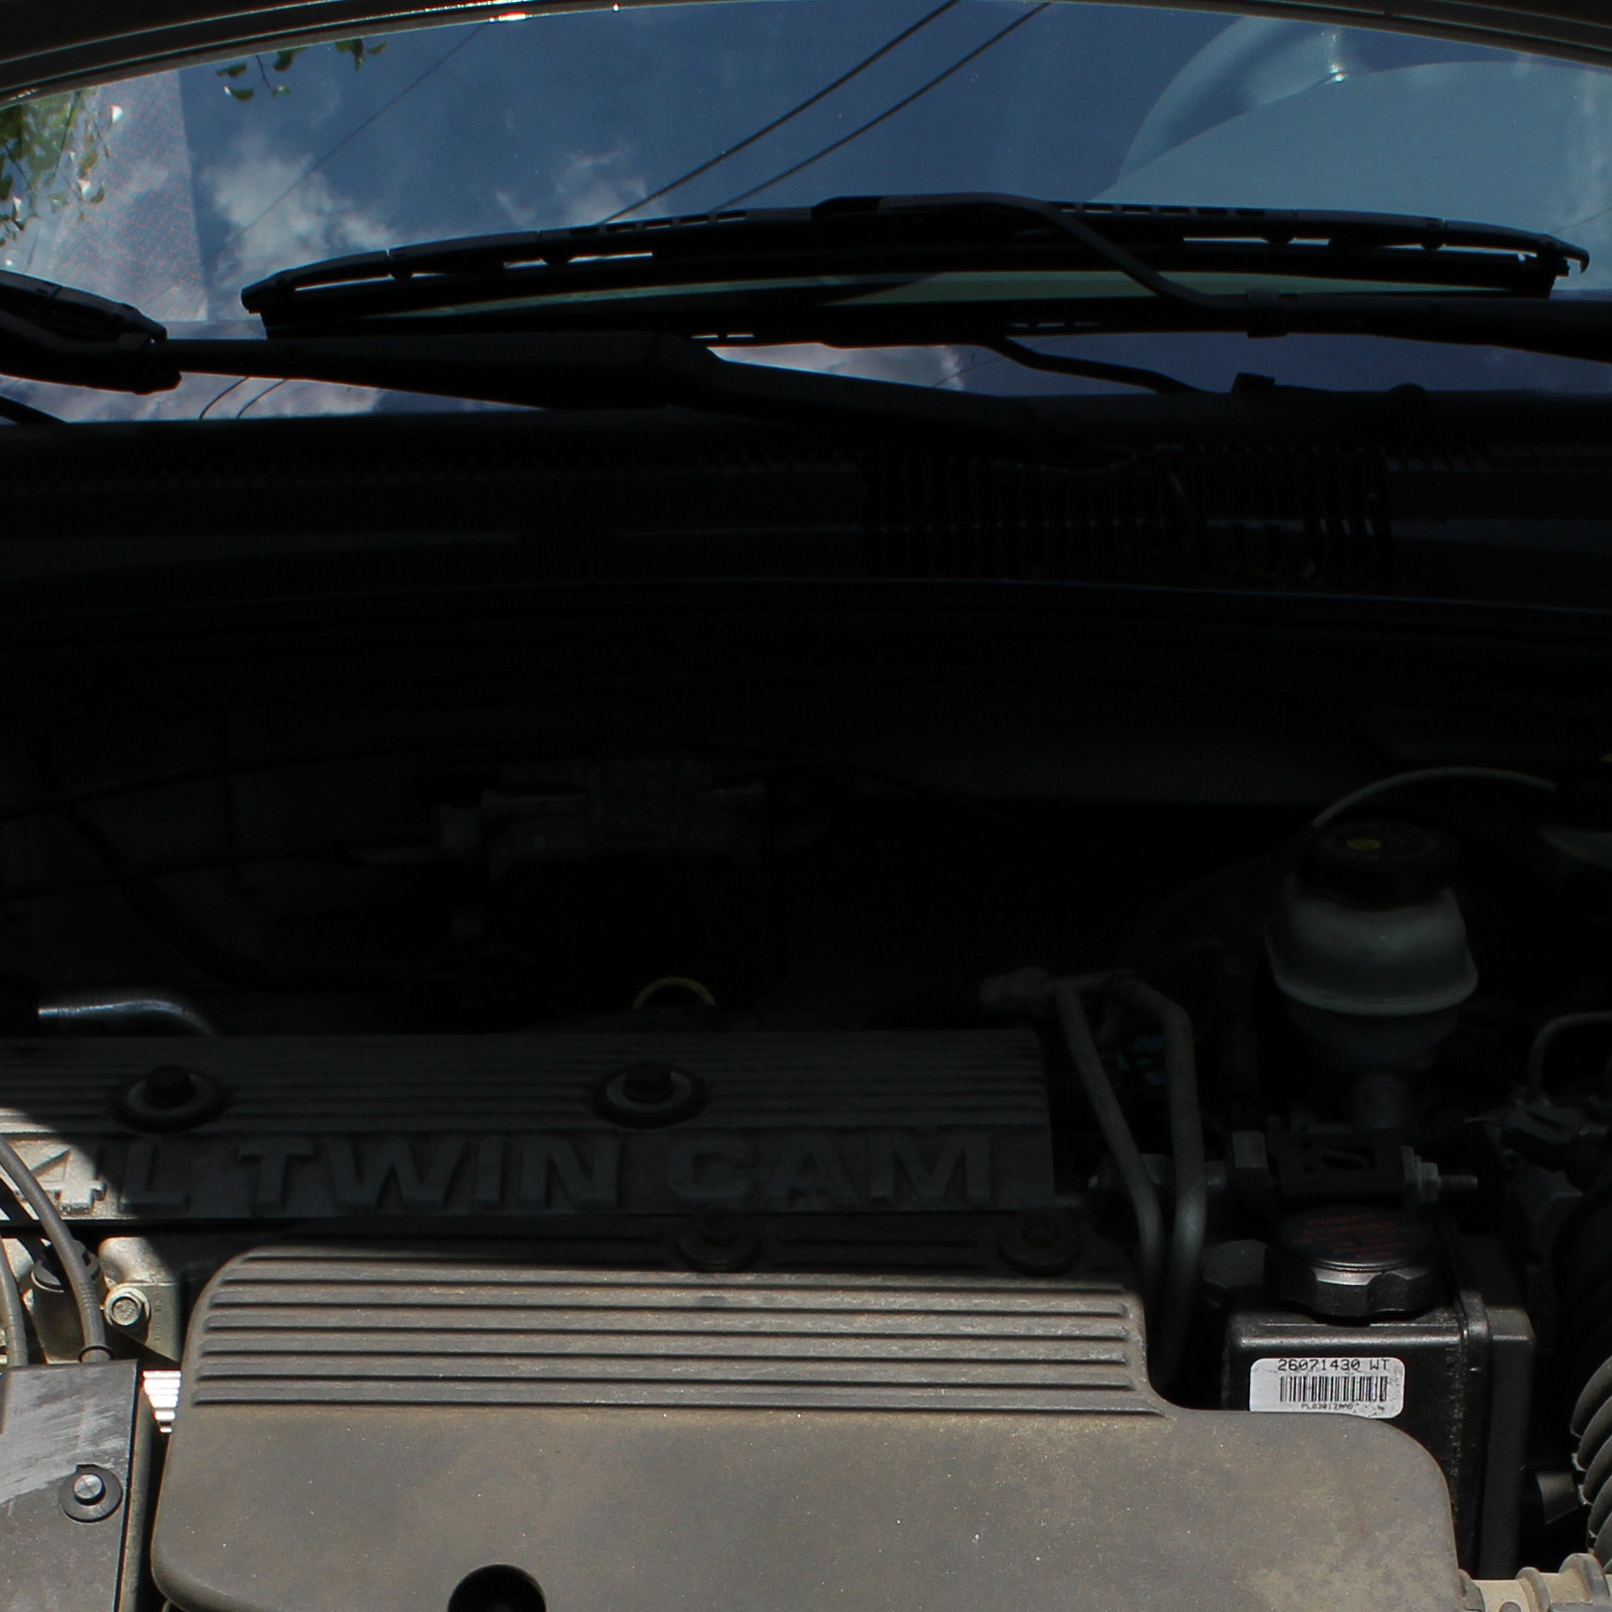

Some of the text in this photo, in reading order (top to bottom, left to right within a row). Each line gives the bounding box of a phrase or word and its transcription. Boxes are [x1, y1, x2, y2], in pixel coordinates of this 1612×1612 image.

[237, 1136, 615, 1213] TWIN
[670, 1136, 984, 1208] CAM
[1277, 1358, 1390, 1371] 26071430 WT
